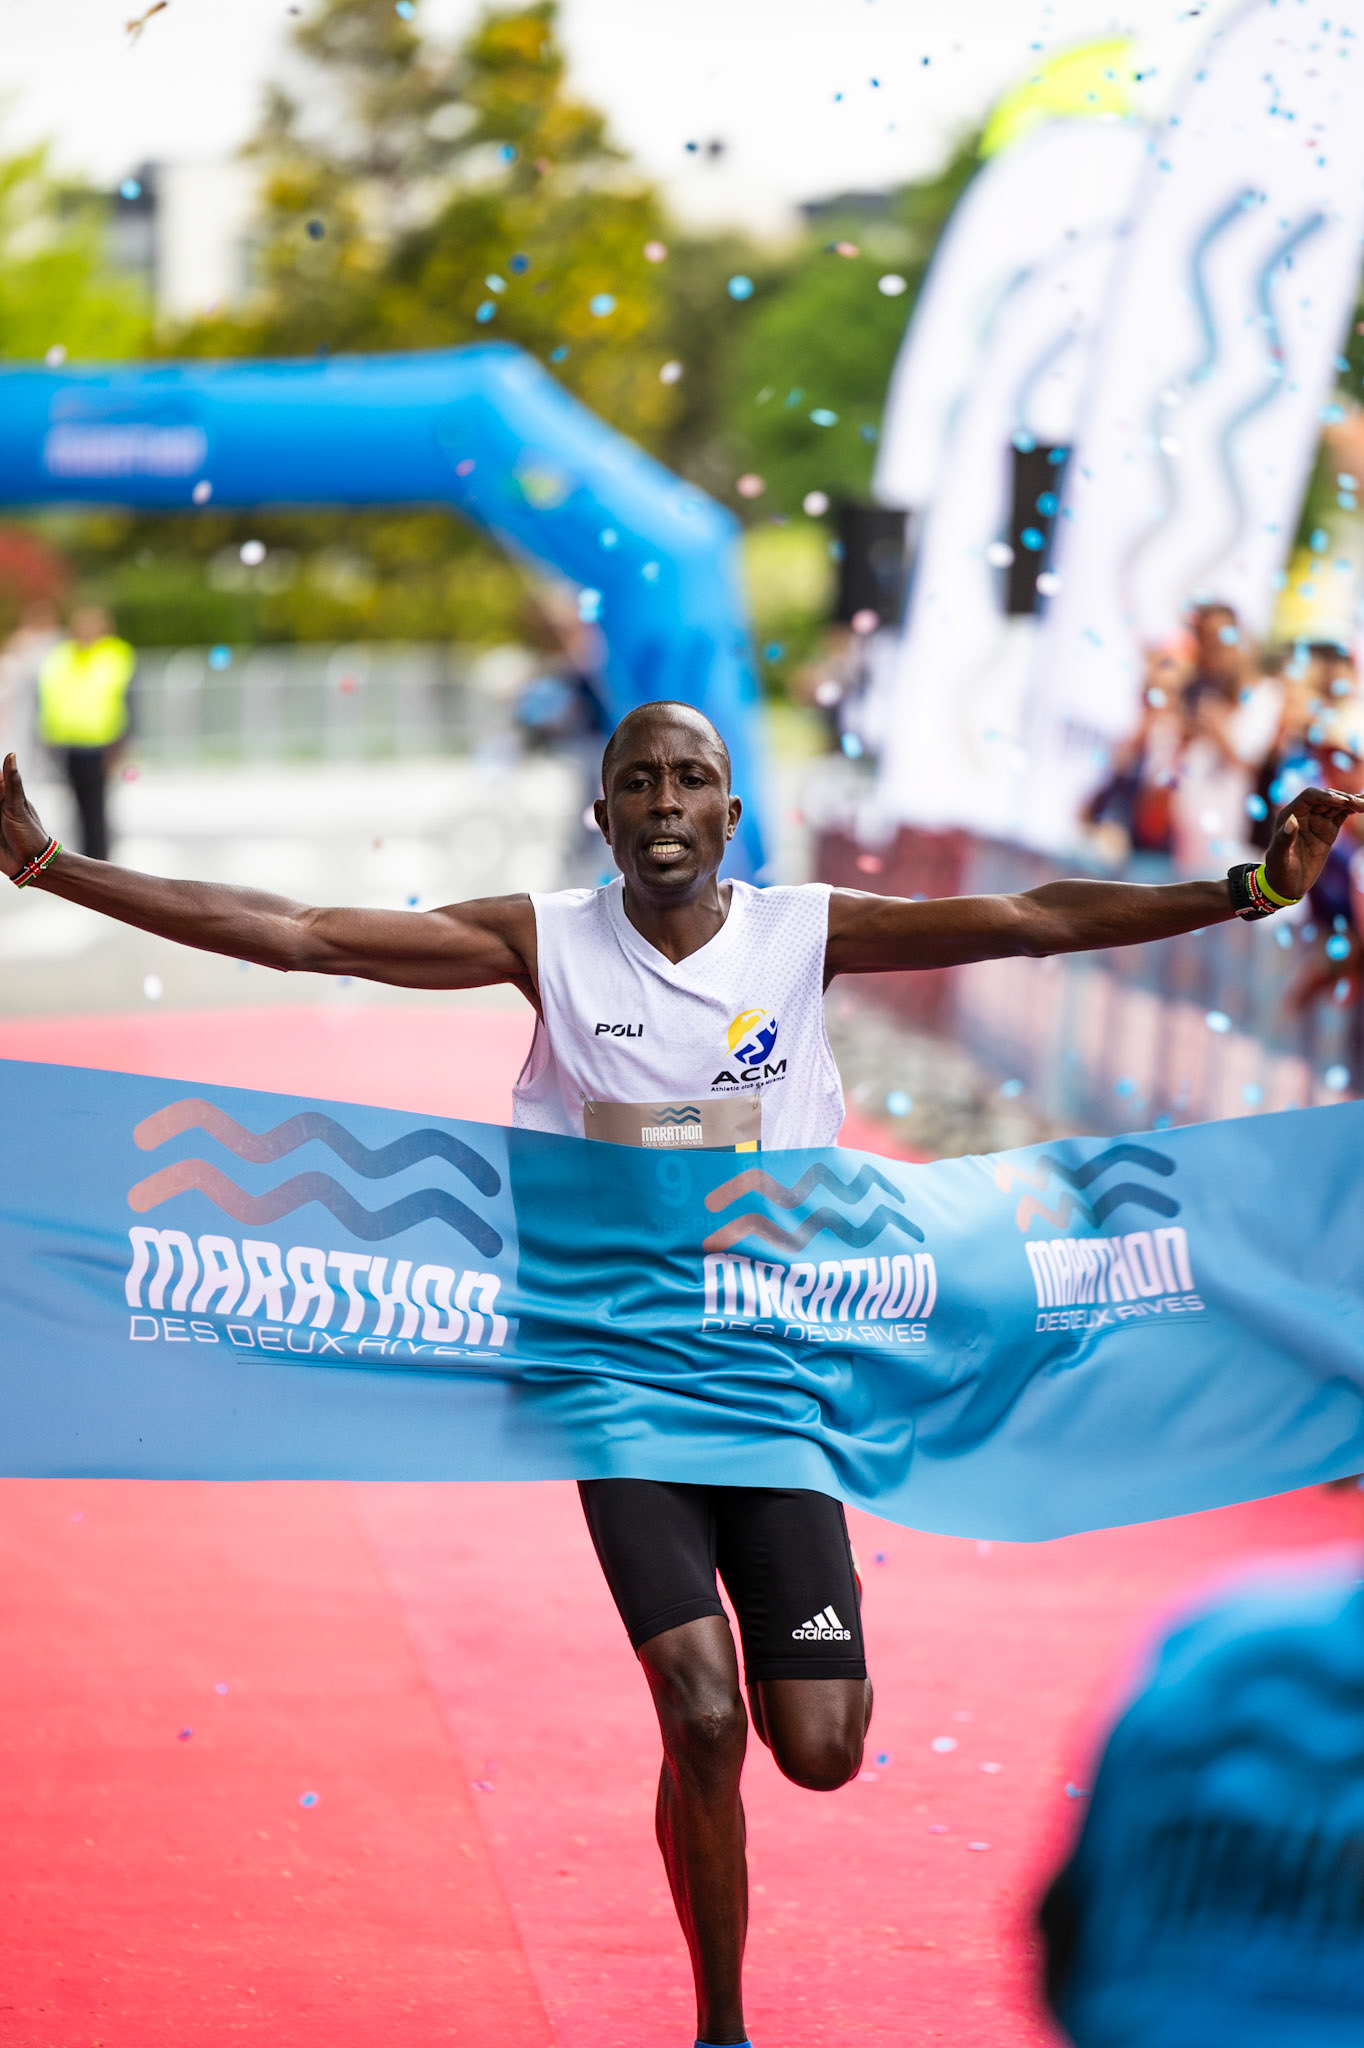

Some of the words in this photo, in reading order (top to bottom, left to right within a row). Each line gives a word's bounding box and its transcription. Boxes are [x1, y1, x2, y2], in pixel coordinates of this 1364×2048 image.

[594, 1022, 643, 1038] POLI
[711, 1060, 787, 1084] ACM
[641, 1125, 703, 1141] MARATHON
[1024, 1226, 1195, 1308] MARATHON
[125, 1226, 508, 1347] MARATHON
[703, 1253, 937, 1322] MARATHON
[1035, 1312, 1070, 1332] DES
[1114, 1295, 1205, 1320] RIVES
[130, 1315, 219, 1343] DES
[227, 1324, 350, 1354] DEUX
[358, 1337, 501, 1356] RIVES
[783, 1324, 858, 1342] DEUX
[857, 1323, 927, 1342] RIVES
[792, 1627, 851, 1640] adidas
